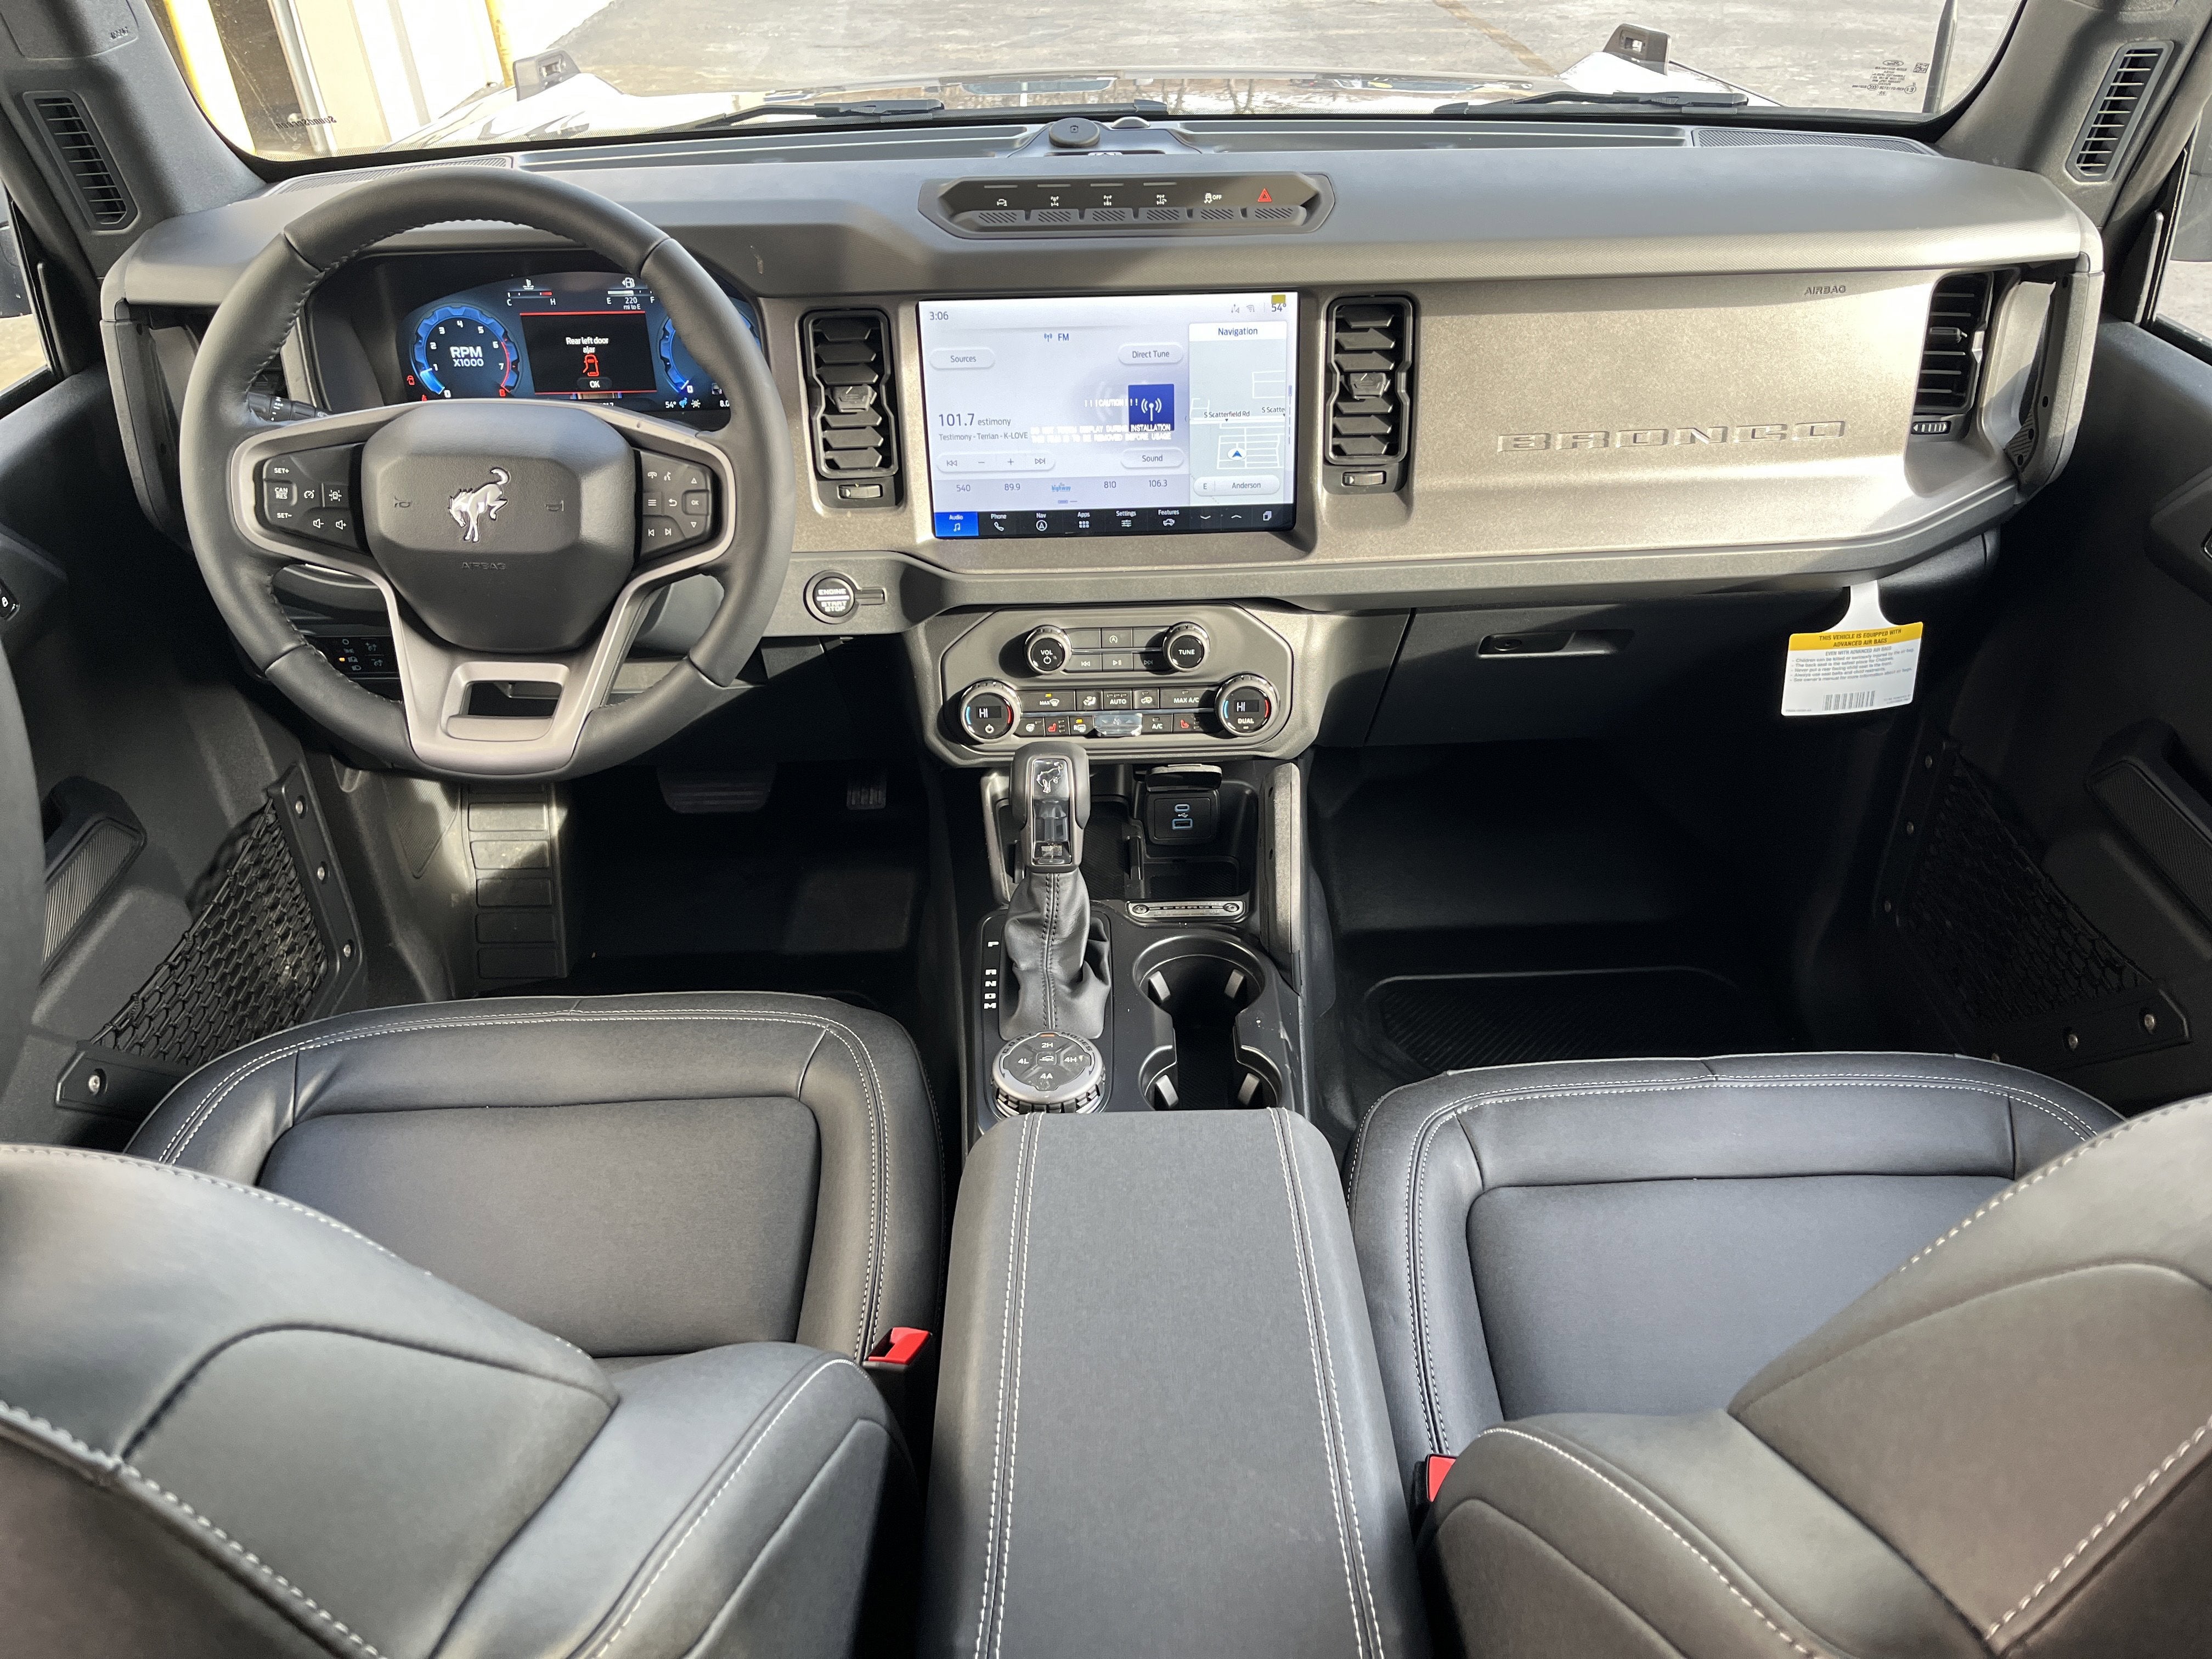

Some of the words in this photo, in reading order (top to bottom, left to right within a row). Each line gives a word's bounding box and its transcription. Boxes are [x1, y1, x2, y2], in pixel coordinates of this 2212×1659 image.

[1803, 285, 1847, 296] AIRBAG
[929, 312, 949, 320] 3:06
[438, 326, 445, 335] 3
[1218, 328, 1258, 337] Navigation
[566, 337, 581, 345] Rear
[1058, 333, 1069, 341] FM
[450, 346, 483, 358] RPM
[1132, 350, 1152, 358] Direct
[1153, 350, 1170, 358] Tune
[453, 358, 484, 367] X1000
[589, 380, 601, 388] OK
[499, 388, 506, 397] 8
[687, 385, 693, 393] 0
[444, 390, 451, 398] 0
[939, 413, 974, 426] 101.7
[978, 418, 1011, 427] estimony
[1131, 424, 1171, 432] INSTALLATION
[1497, 421, 1846, 452] BRONCO
[1104, 481, 1116, 489] 810
[1236, 702, 1245, 712] HI
[979, 708, 988, 718] HI
[1061, 1031, 1093, 1051] MODES
